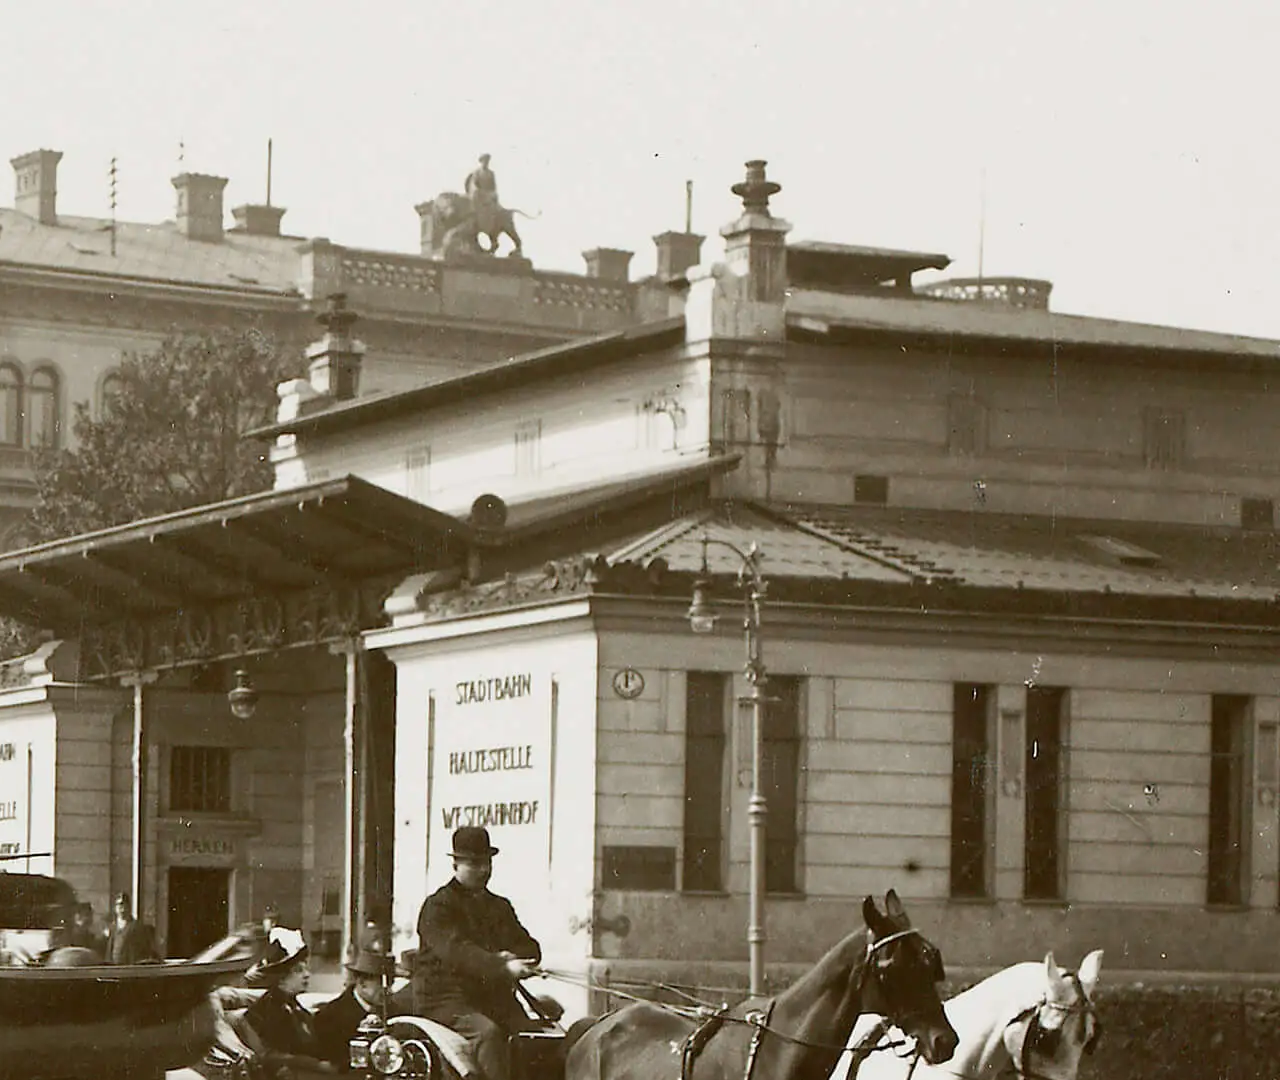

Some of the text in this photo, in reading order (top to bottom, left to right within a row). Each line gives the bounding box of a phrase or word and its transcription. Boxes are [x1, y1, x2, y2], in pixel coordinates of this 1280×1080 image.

[455, 673, 532, 706] STADTBAHN
[449, 745, 533, 775] HALTESTELLE
[442, 800, 539, 829] WESTBAHNHOF
